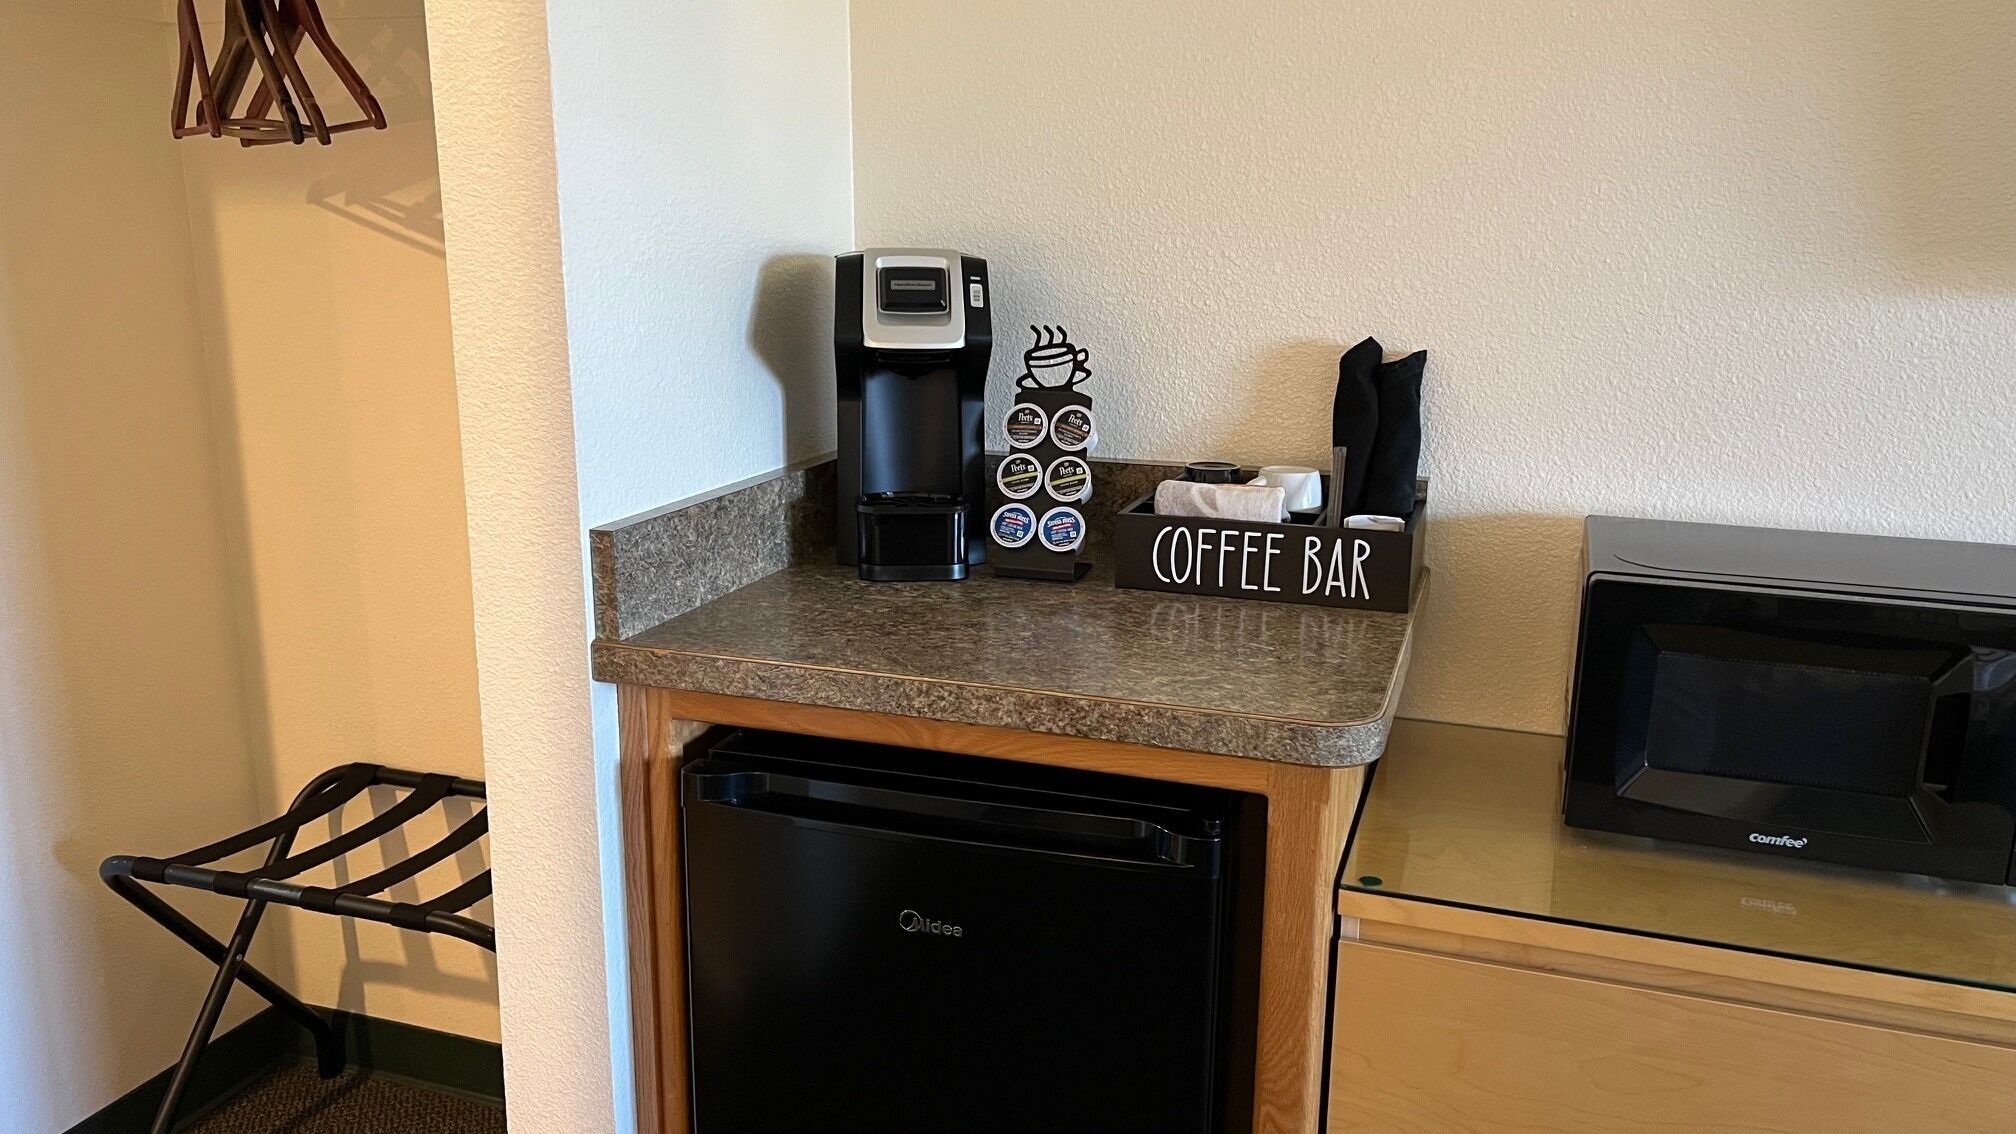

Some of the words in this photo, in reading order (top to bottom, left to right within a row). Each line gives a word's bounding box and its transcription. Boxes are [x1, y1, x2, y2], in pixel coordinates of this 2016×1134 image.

[1152, 526, 1285, 592] COFFEE
[1302, 536, 1371, 600] BAR
[899, 909, 963, 937] Midea
